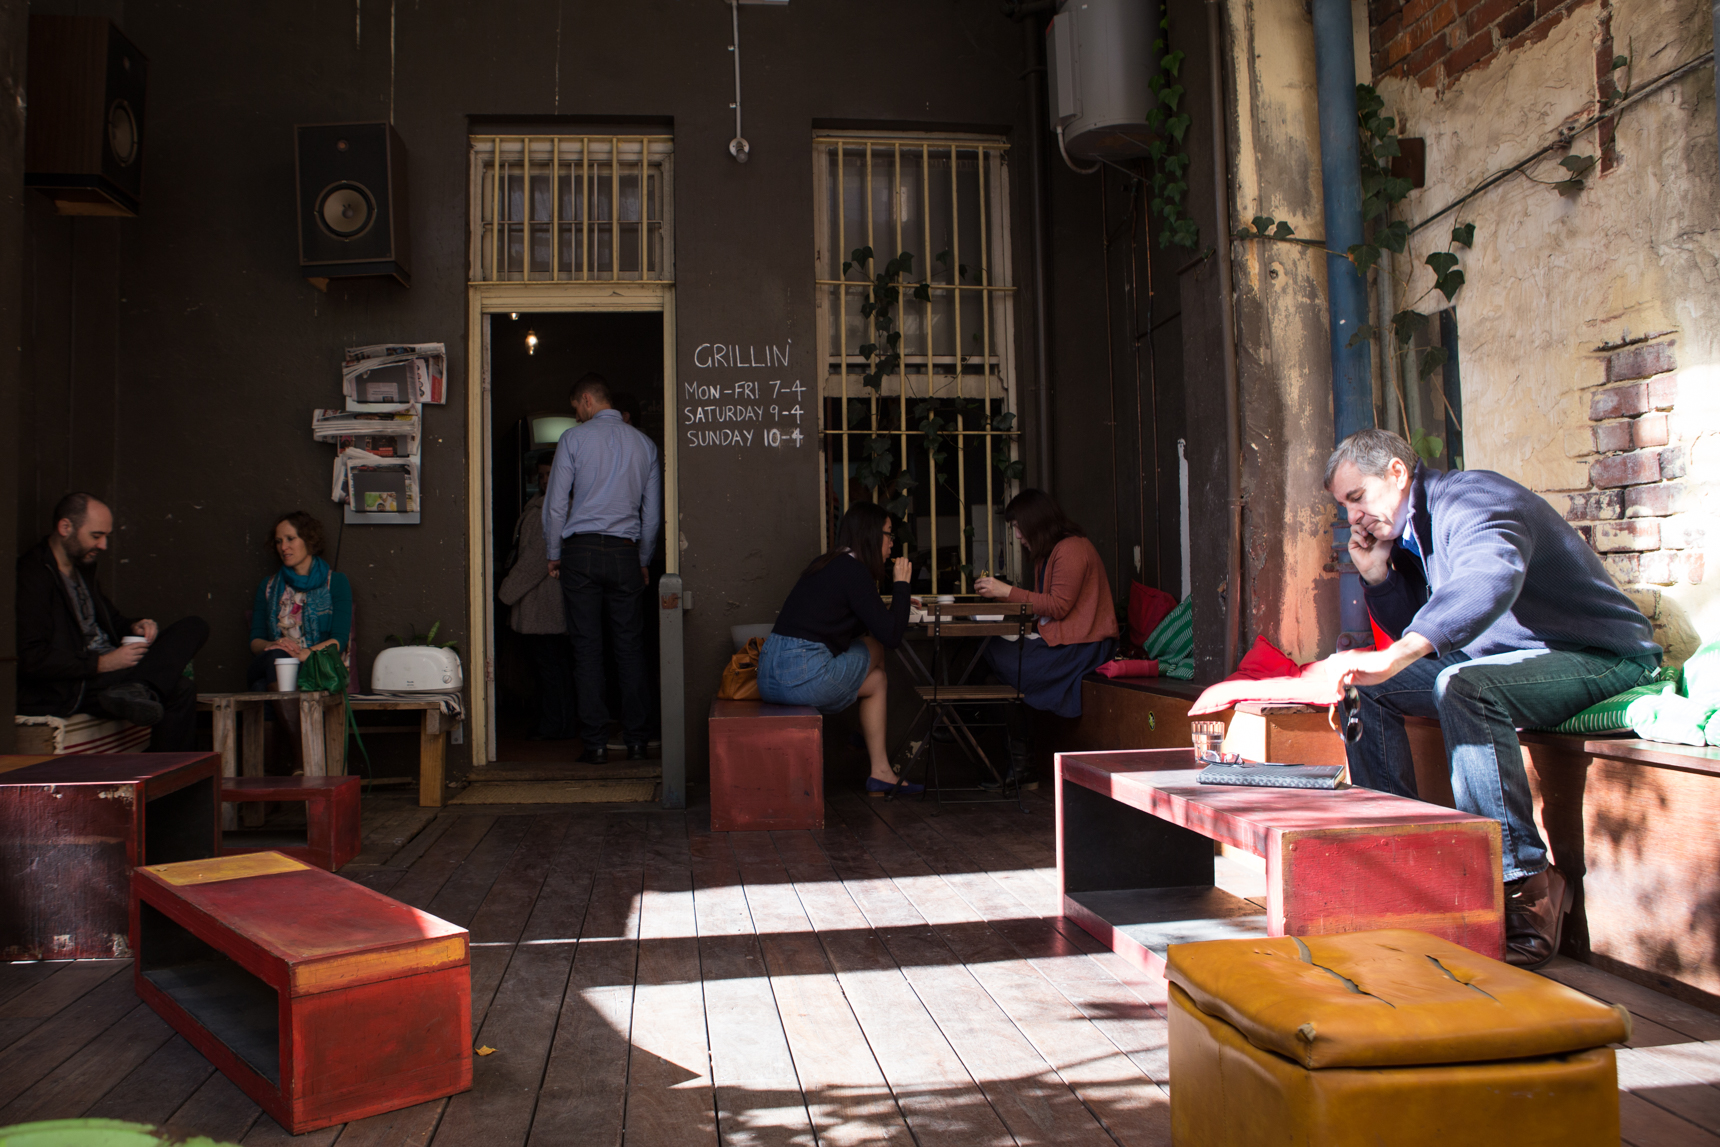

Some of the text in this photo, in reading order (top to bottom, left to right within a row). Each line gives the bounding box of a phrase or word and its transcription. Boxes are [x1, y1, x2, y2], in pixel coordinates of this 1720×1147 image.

[769, 379, 807, 402] 7-4
[684, 404, 804, 425] SATURDAY 9-4
[687, 427, 805, 448] SUNDAY 10-4
